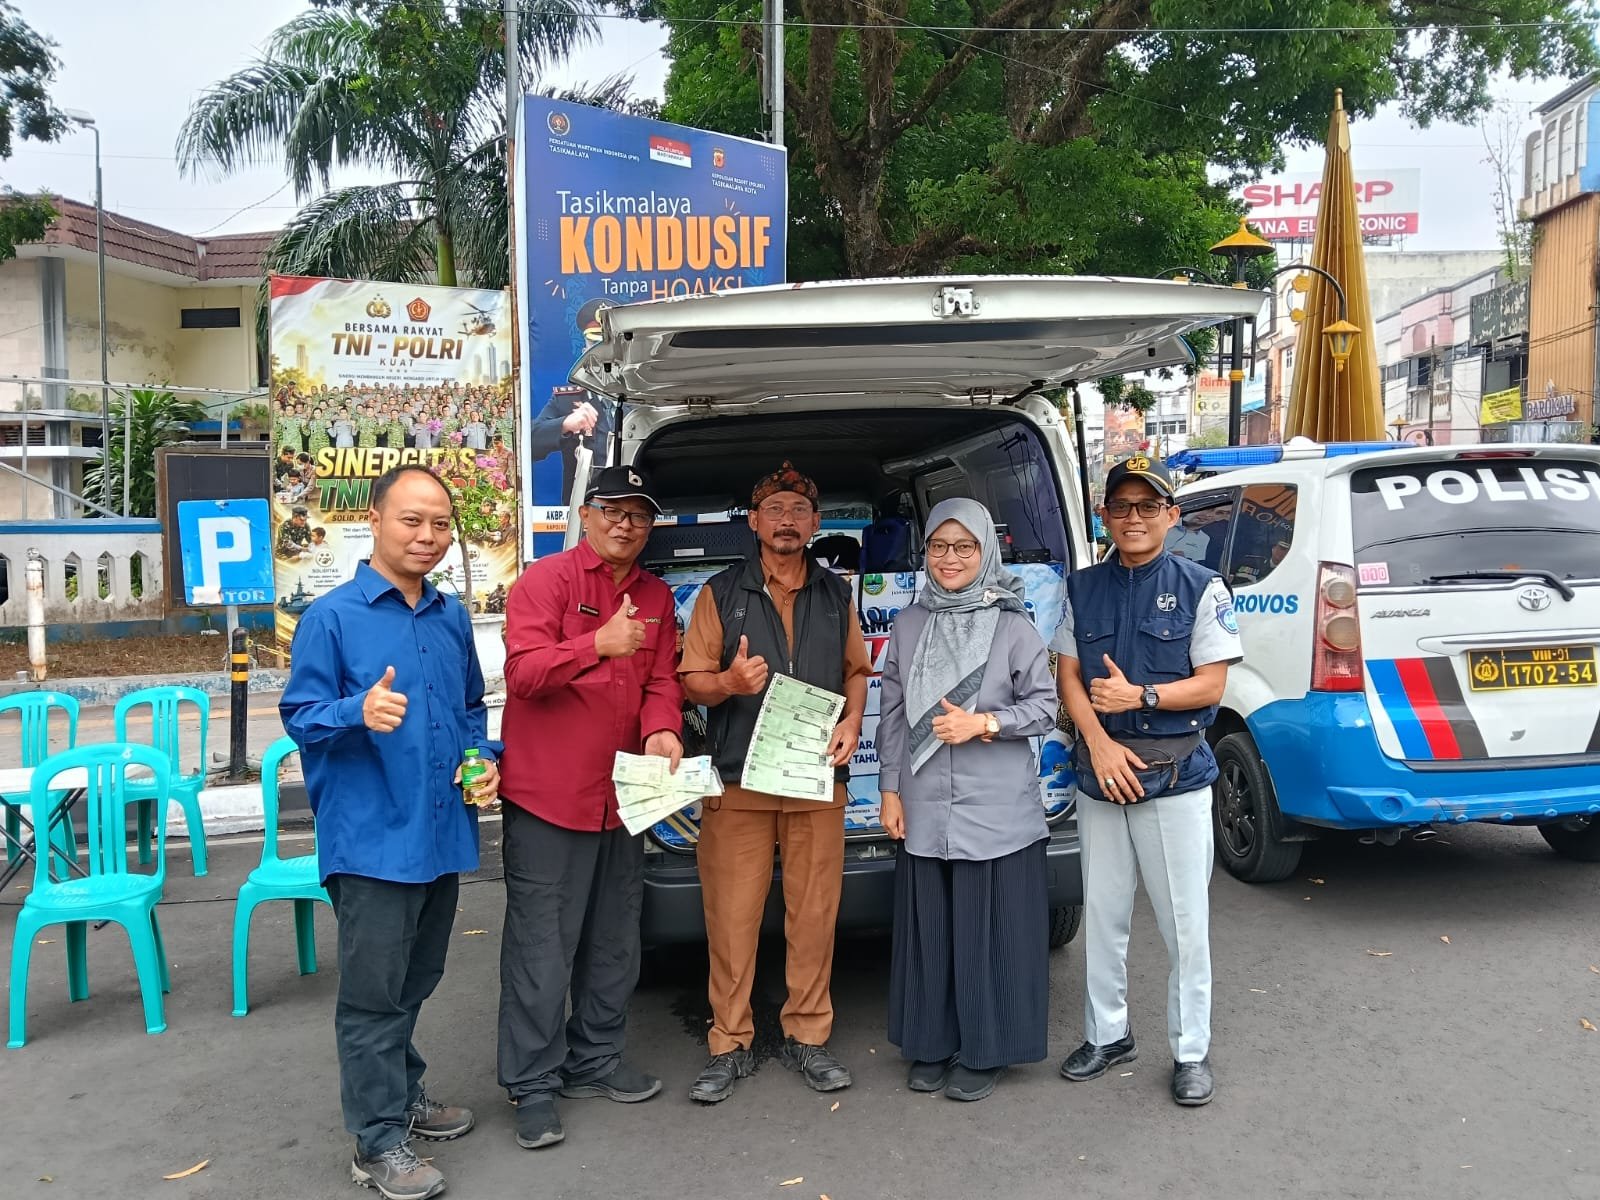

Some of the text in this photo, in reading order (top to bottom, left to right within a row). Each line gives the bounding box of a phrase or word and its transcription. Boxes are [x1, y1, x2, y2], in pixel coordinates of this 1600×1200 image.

[549, 145, 590, 160] TASIKMALAYA
[556, 190, 691, 219] Tasikmalaya
[560, 215, 771, 275] KONDUSIF
[601, 277, 649, 299] Tanpa
[345, 322, 443, 336] BERSAMA RAKYAT
[331, 333, 373, 356] TNI
[393, 336, 463, 360] POLRI
[379, 358, 415, 367] KUAT
[315, 478, 372, 512] TNI
[546, 510, 565, 521] AKBP.
[198, 516, 253, 588] P
[1232, 594, 1299, 615] ROVOS
[1511, 662, 1593, 685] 1702-54
